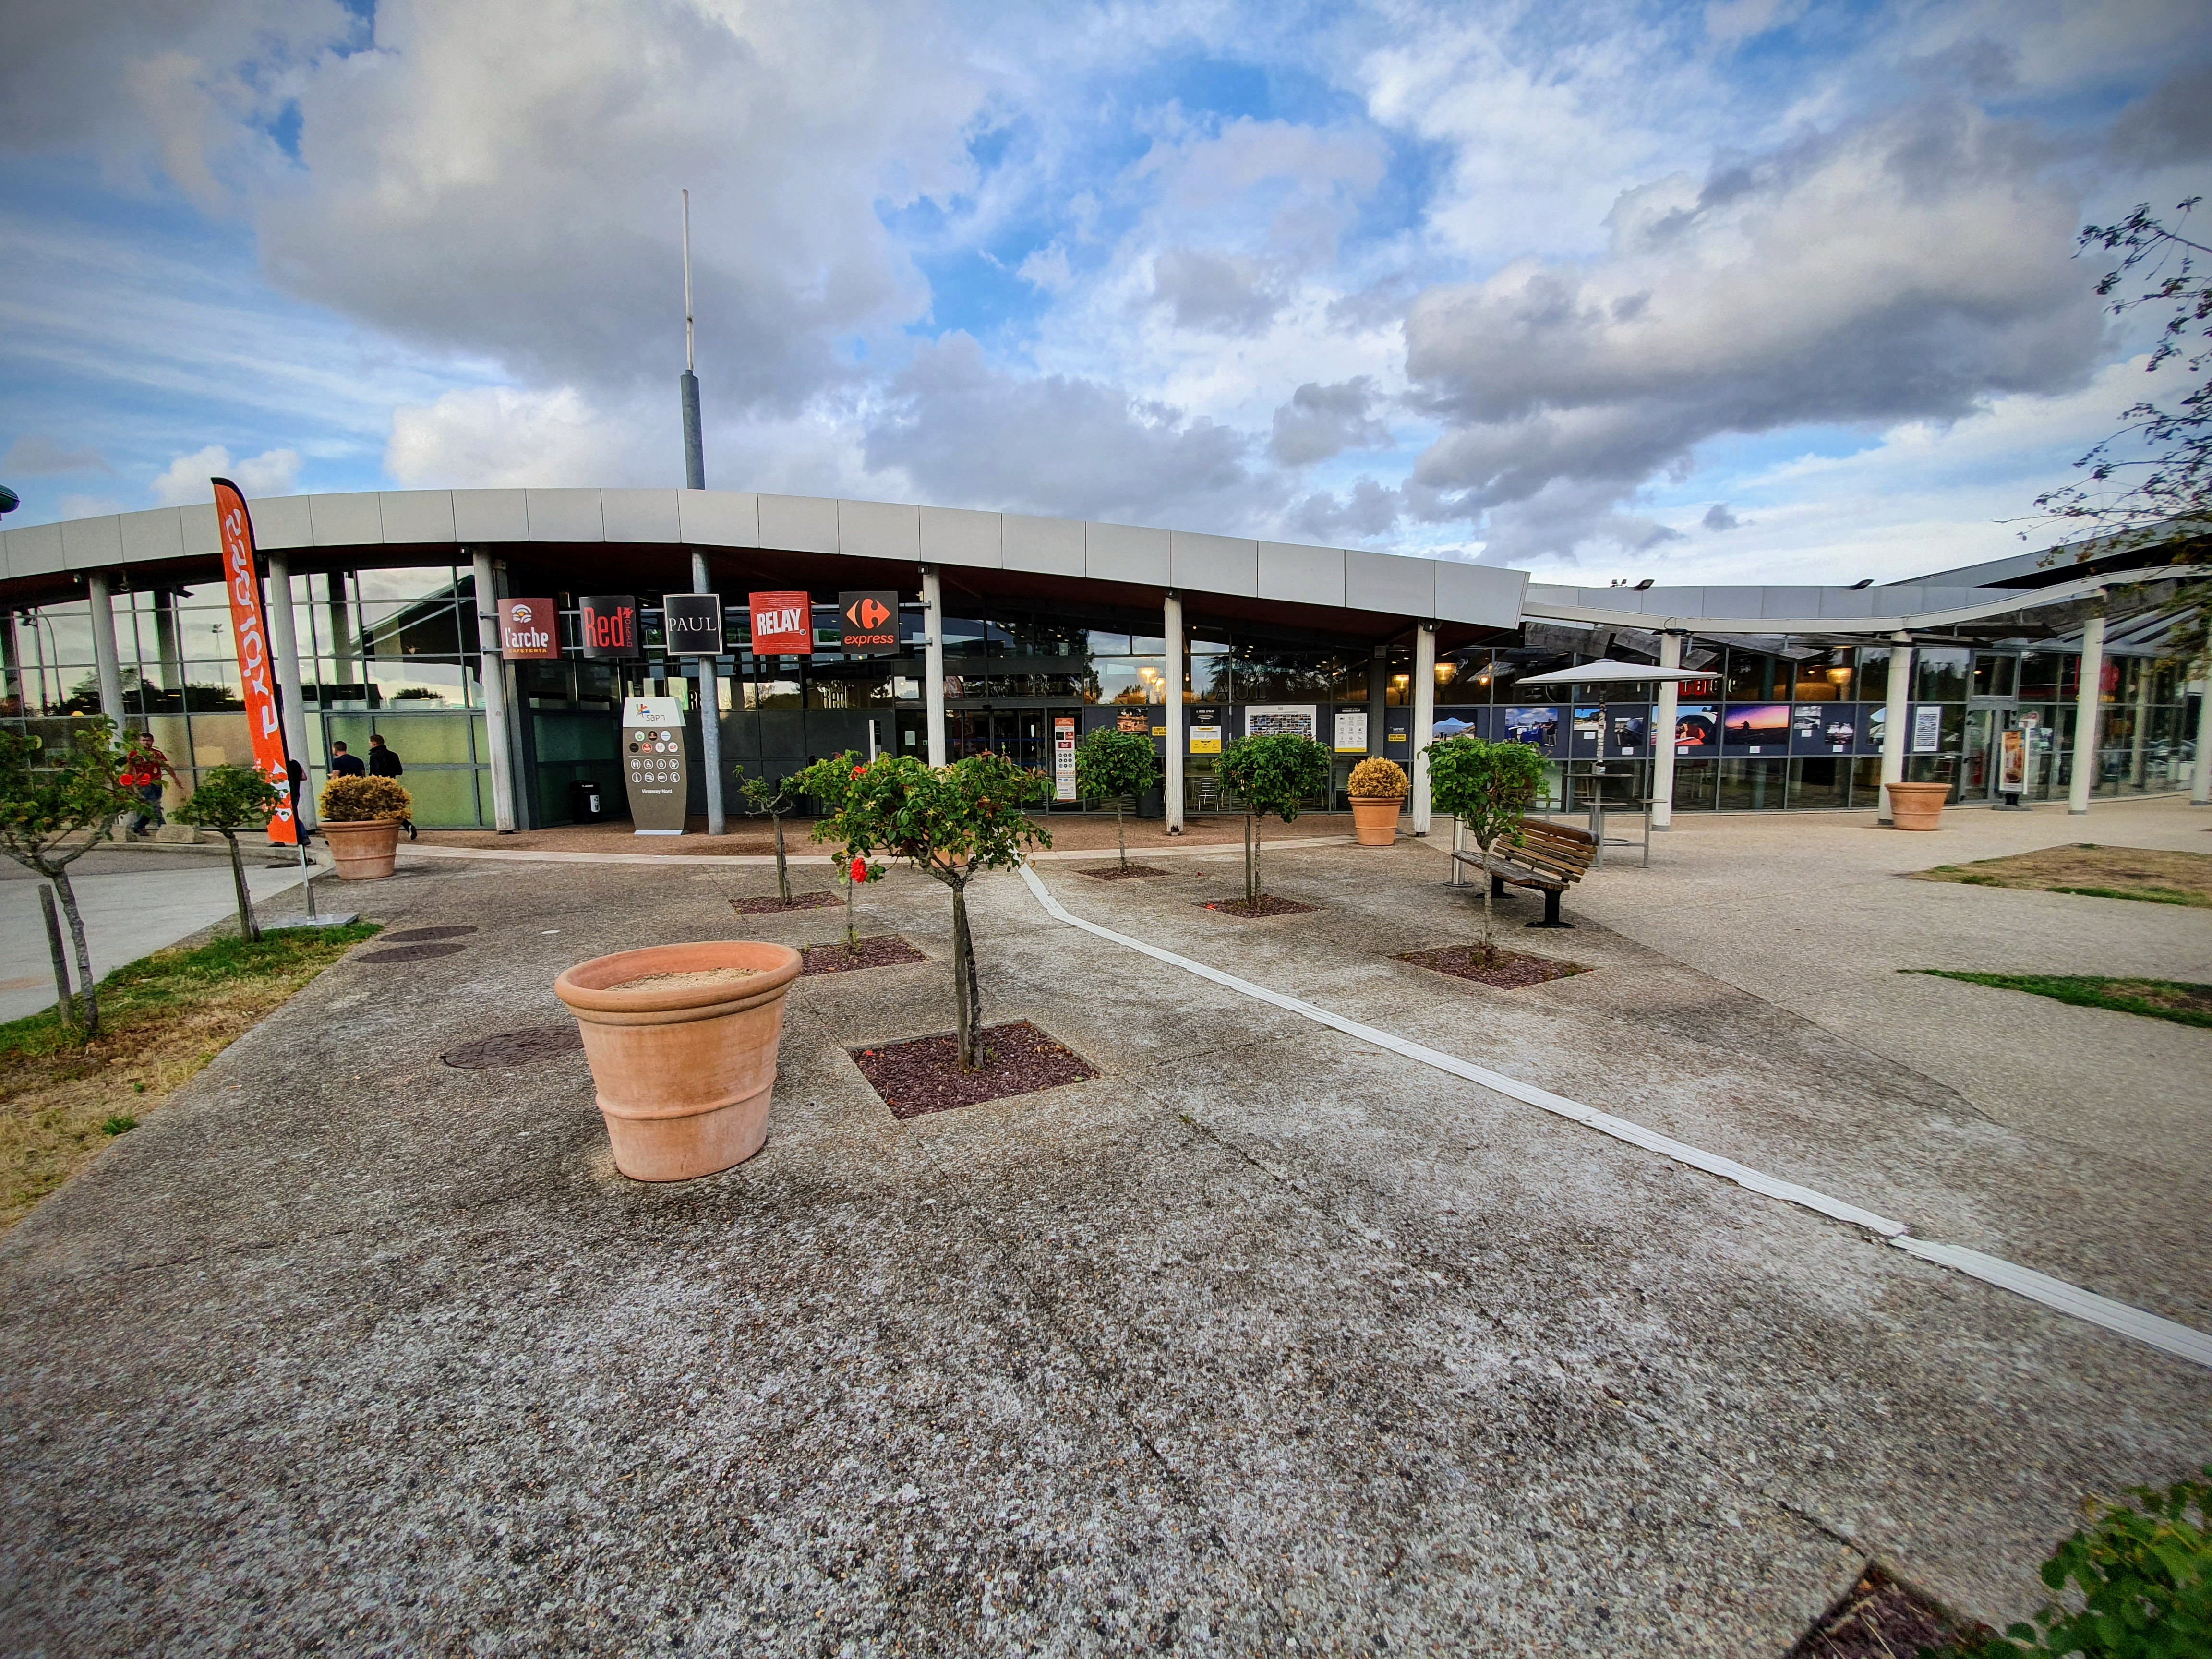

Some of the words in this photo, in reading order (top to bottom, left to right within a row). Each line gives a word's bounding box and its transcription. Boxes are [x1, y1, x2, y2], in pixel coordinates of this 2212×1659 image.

[584, 606, 625, 647] Red
[669, 617, 717, 632] PAUL
[757, 608, 801, 636] RELAY
[505, 626, 549, 648] l'arche
[844, 634, 894, 647] express
[823, 686, 848, 709] Red
